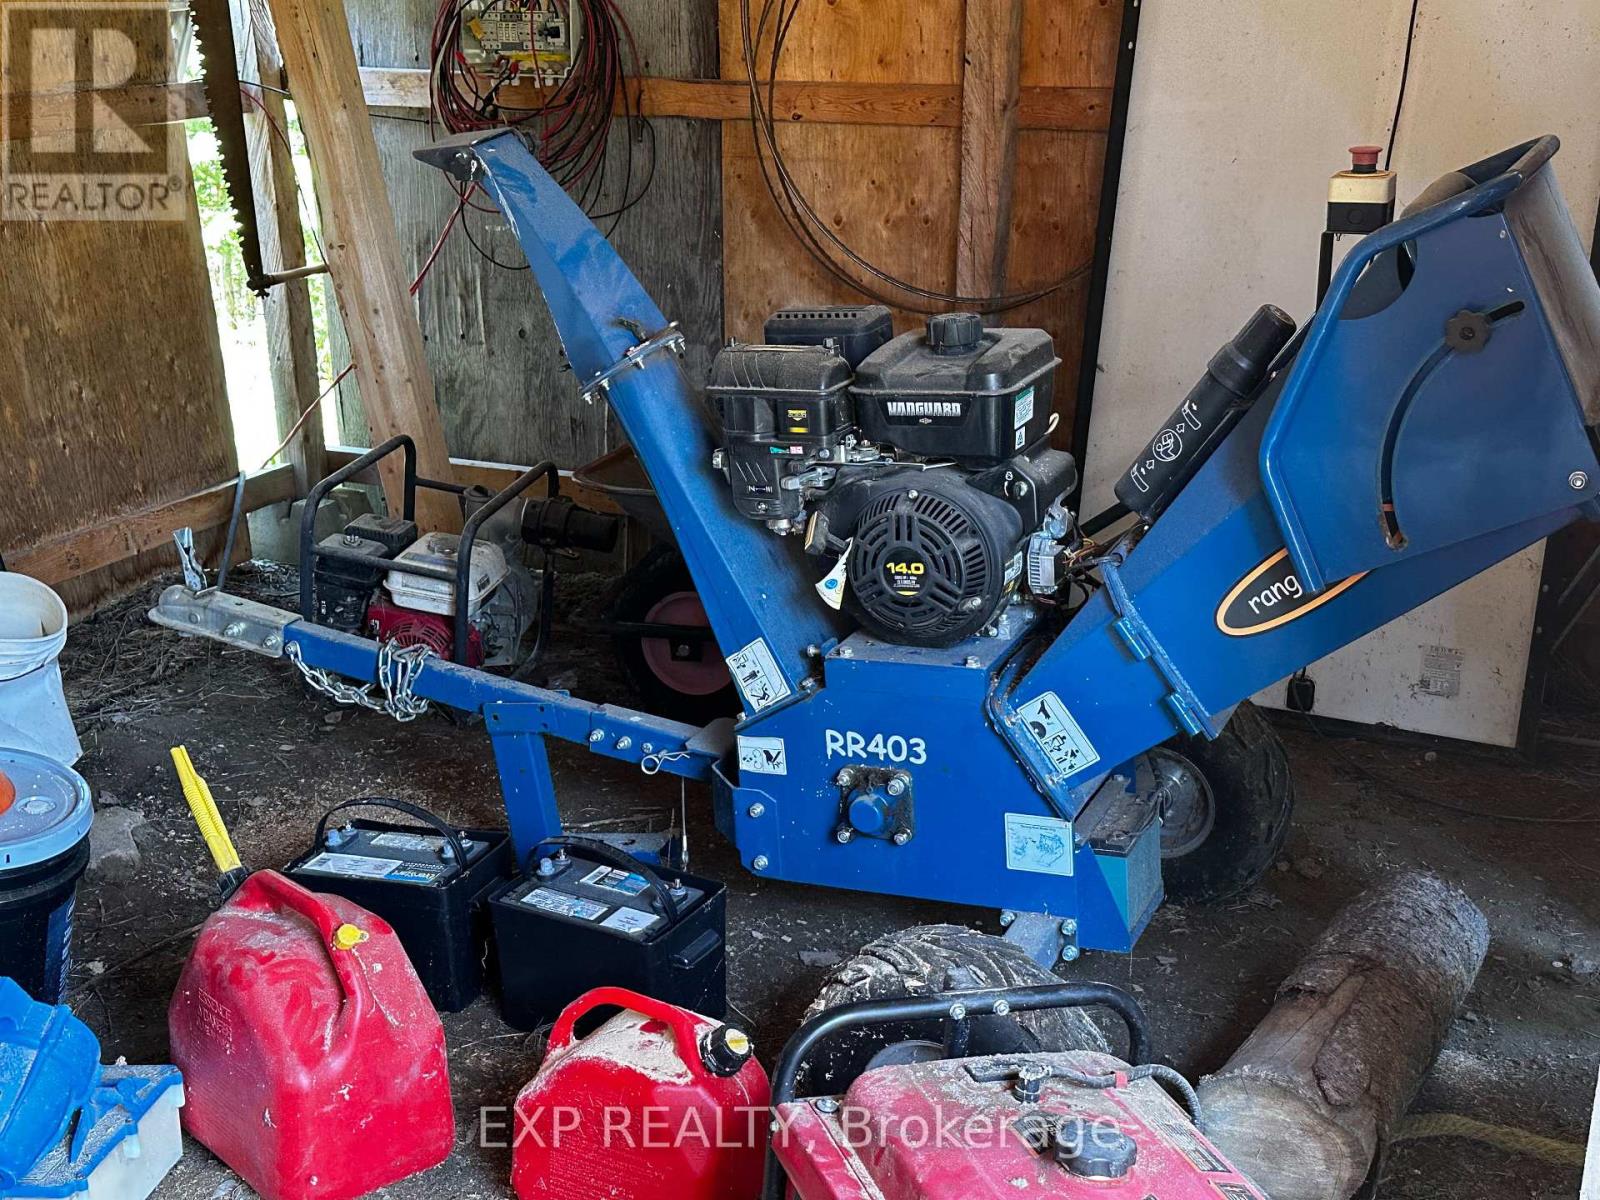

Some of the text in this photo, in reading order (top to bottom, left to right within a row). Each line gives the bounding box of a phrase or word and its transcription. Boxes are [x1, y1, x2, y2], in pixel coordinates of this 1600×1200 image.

[887, 401, 962, 417] VANGUARD
[886, 562, 925, 575] 14.0
[1247, 574, 1303, 615] rang
[825, 728, 928, 765] RR403
